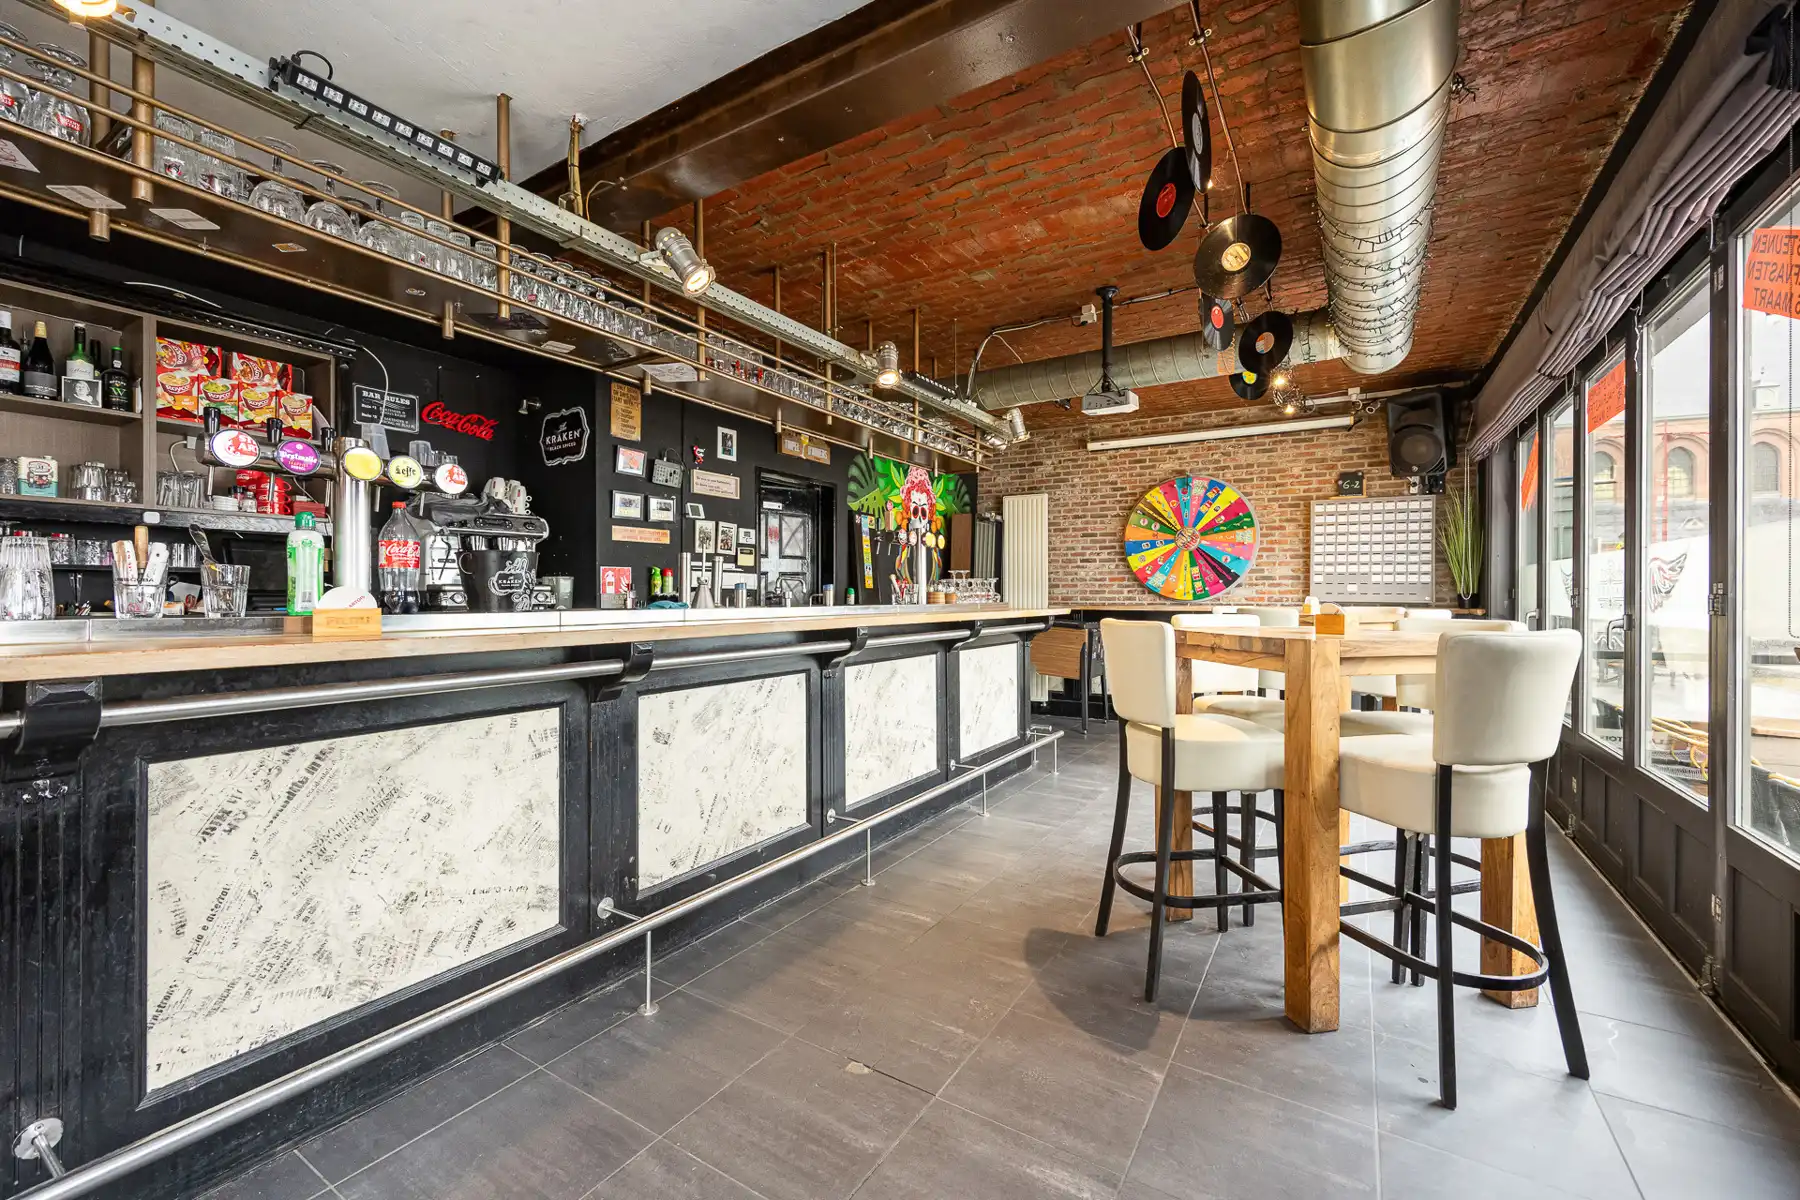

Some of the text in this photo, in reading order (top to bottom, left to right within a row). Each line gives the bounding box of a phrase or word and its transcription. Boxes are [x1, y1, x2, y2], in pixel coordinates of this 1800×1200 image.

[362, 390, 381, 400] BAR
[422, 401, 499, 441] Coca-Cola
[545, 428, 581, 446] KRAKEN
